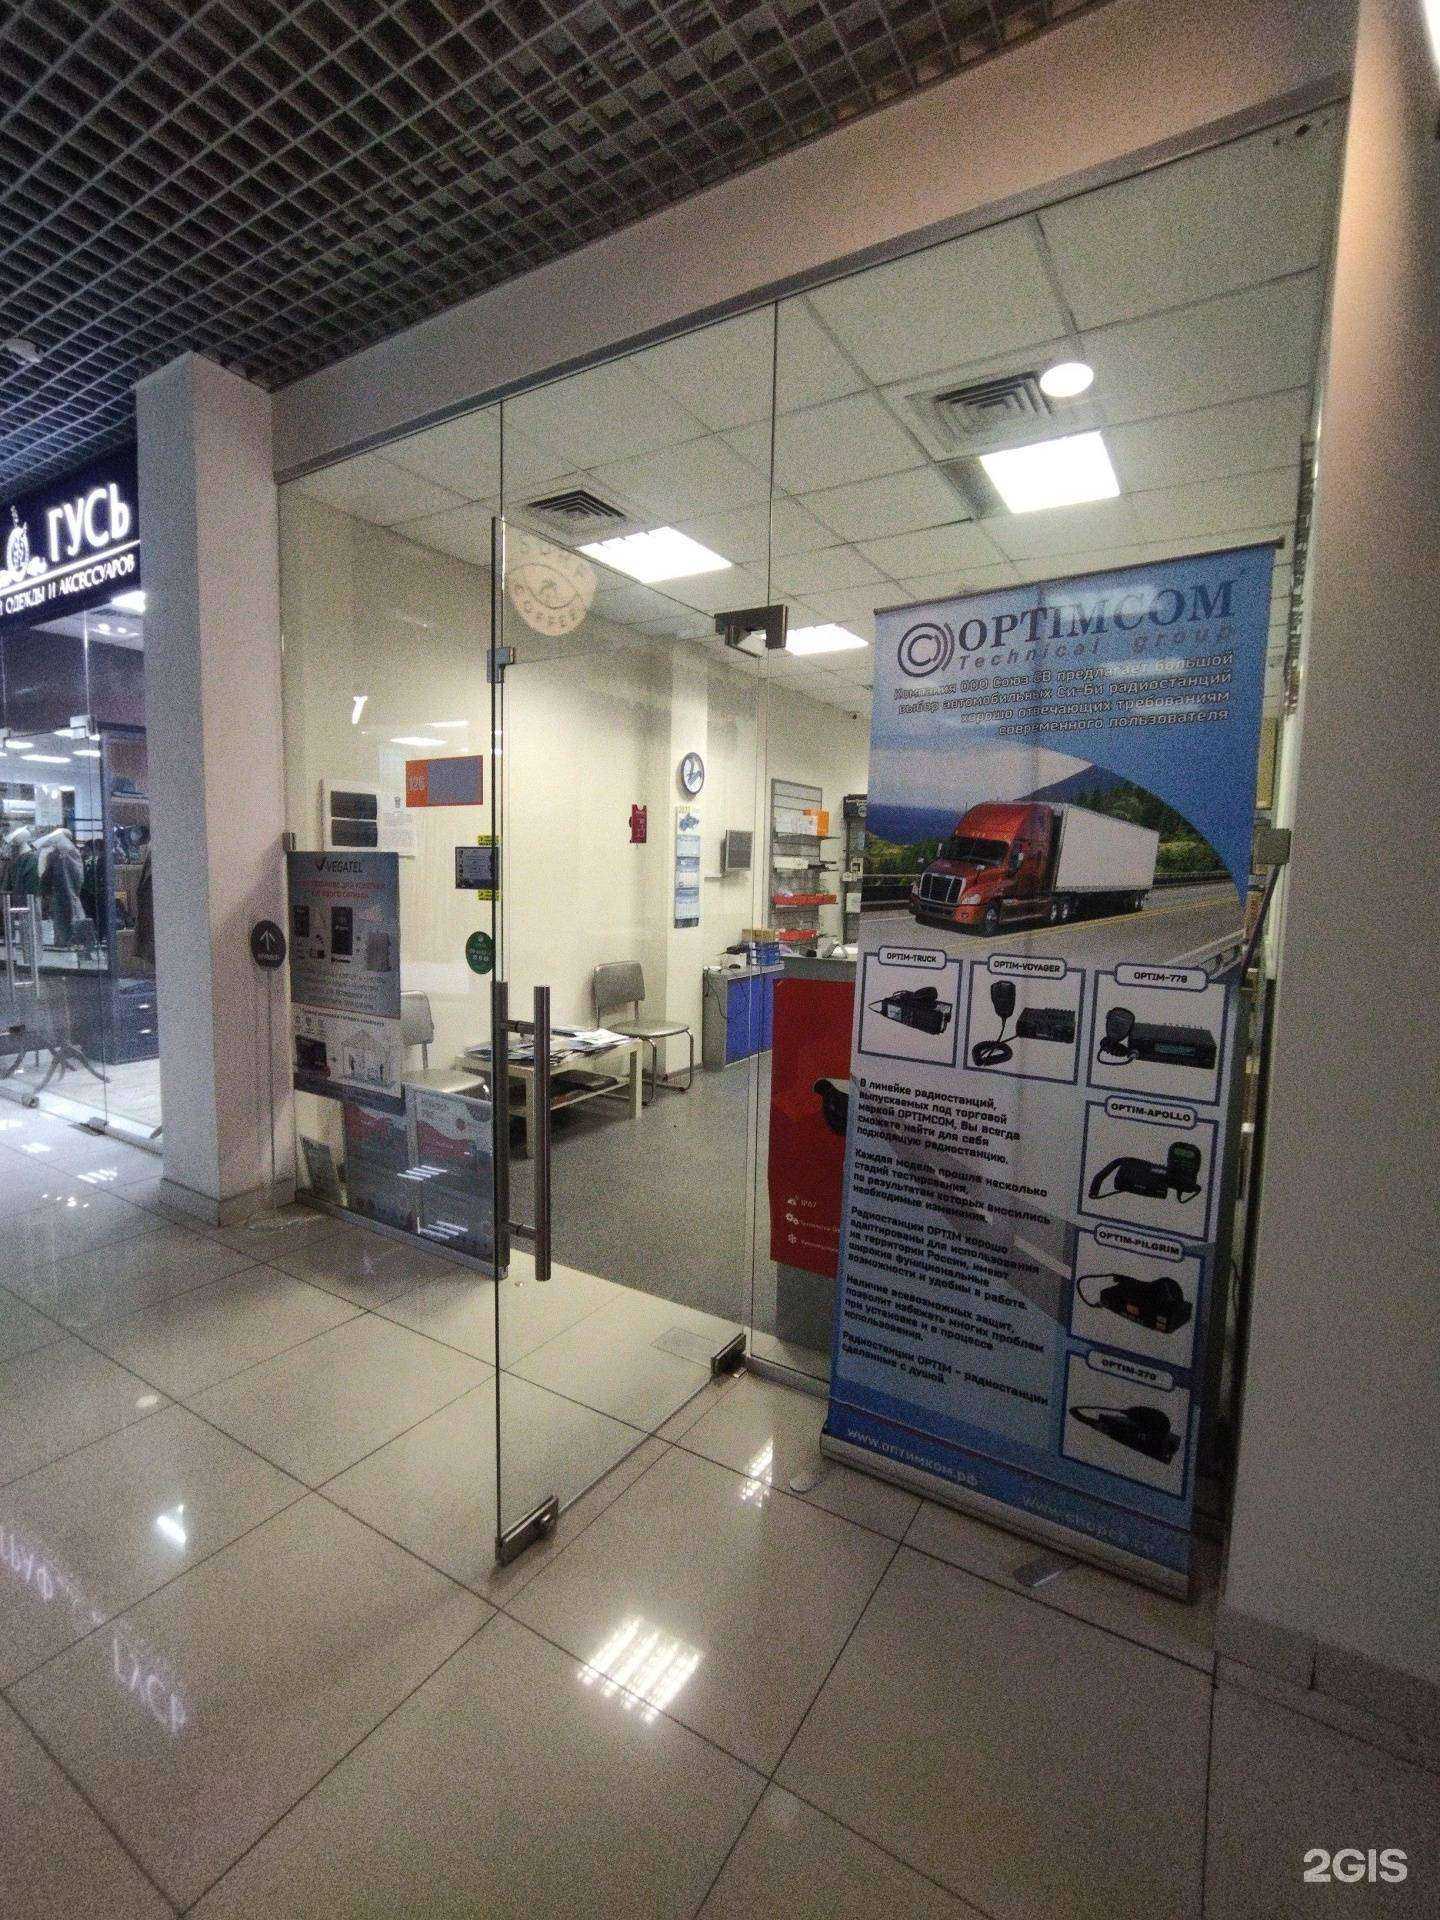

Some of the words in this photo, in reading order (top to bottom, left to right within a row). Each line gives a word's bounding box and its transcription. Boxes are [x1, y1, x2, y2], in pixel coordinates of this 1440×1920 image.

[48, 483, 130, 562] ГУСЬ
[59, 554, 135, 595] АКСЕССУАРОВ
[958, 580, 1238, 651] OPTIMCOM
[958, 639, 1100, 670] Technical
[894, 683, 956, 700] Компания
[961, 679, 988, 691] ООО
[993, 675, 1029, 690] Союз
[1058, 663, 1148, 685] предлагает
[1155, 651, 1233, 672] большой
[899, 699, 939, 715] выбор
[943, 688, 1051, 710] автомобильных
[1057, 684, 1103, 697] Си-Би
[1109, 669, 1231, 695] радиостанций
[961, 710, 1013, 725] хорошо
[1019, 701, 1112, 718] отвечающих
[1116, 692, 1229, 712] требованиям
[1000, 720, 1103, 736] современного
[1109, 710, 1229, 729] пользователя
[325, 860, 363, 873] VEGATEL
[886, 952, 936, 963] OPTIM-TRUCK
[993, 960, 1060, 972] OPTIM-VOYAGER
[859, 1091, 929, 1110] выпускаемых
[932, 1104, 952, 1117] под
[956, 1108, 1007, 1125] торговой
[860, 1078, 866, 1087] В
[869, 1081, 911, 1095] линейке
[915, 1089, 996, 1110] радиостанций,
[1110, 1103, 1191, 1122] OPTIM-APOLLO
[857, 1115, 900, 1129] сможете
[904, 1123, 935, 1136] найти
[938, 1130, 958, 1142] для
[962, 1134, 989, 1146] себя
[858, 1103, 894, 1116] маркой
[898, 1108, 957, 1130] OPTIMCOM,
[961, 1120, 977, 1132] Вы
[981, 1125, 1020, 1141] всегда
[857, 1126, 921, 1146] подходящую
[924, 1140, 1008, 1164] радиостанцию.
[854, 1161, 889, 1175] стадий
[892, 1170, 969, 1195] тестирования,
[855, 1148, 892, 1164] Каждая
[896, 1159, 935, 1174] модель
[938, 1168, 982, 1184] прошла
[986, 1178, 1048, 1198] несколько
[853, 1184, 922, 1208] необходимые
[853, 1173, 865, 1182] по
[867, 1176, 934, 1197] результатам
[937, 1193, 984, 1209] которых
[987, 1204, 1051, 1225] вносились
[850, 1219, 924, 1244] адаптированы
[927, 1239, 947, 1250] для
[950, 1245, 1040, 1275] использования
[851, 1206, 924, 1231] Радиостанции
[927, 1225, 961, 1241] OPTIM
[964, 1237, 1008, 1254] хорошо
[1099, 1231, 1180, 1254] OPTIM-PILGRIM
[848, 1252, 916, 1278] возможности
[928, 1275, 971, 1293] удобны
[849, 1230, 861, 1240] на
[864, 1234, 924, 1256] территории
[927, 1249, 969, 1269] России,
[973, 1263, 1009, 1279] имеют
[849, 1242, 892, 1260] широкие
[895, 1254, 990, 1287] функциональные
[847, 1274, 888, 1294] Наличие
[891, 1289, 972, 1318] всевозможных
[845, 1299, 863, 1310] при
[865, 1304, 918, 1327] установке
[940, 1328, 994, 1351] процессе
[846, 1287, 892, 1306] позволит
[895, 1302, 946, 1324] избежать
[948, 1318, 988, 1336] многих
[991, 1331, 1044, 1352] проблем
[842, 1330, 914, 1361] Радиостанции
[917, 1354, 952, 1374] OPTIM
[963, 1372, 1049, 1406] радиостанции
